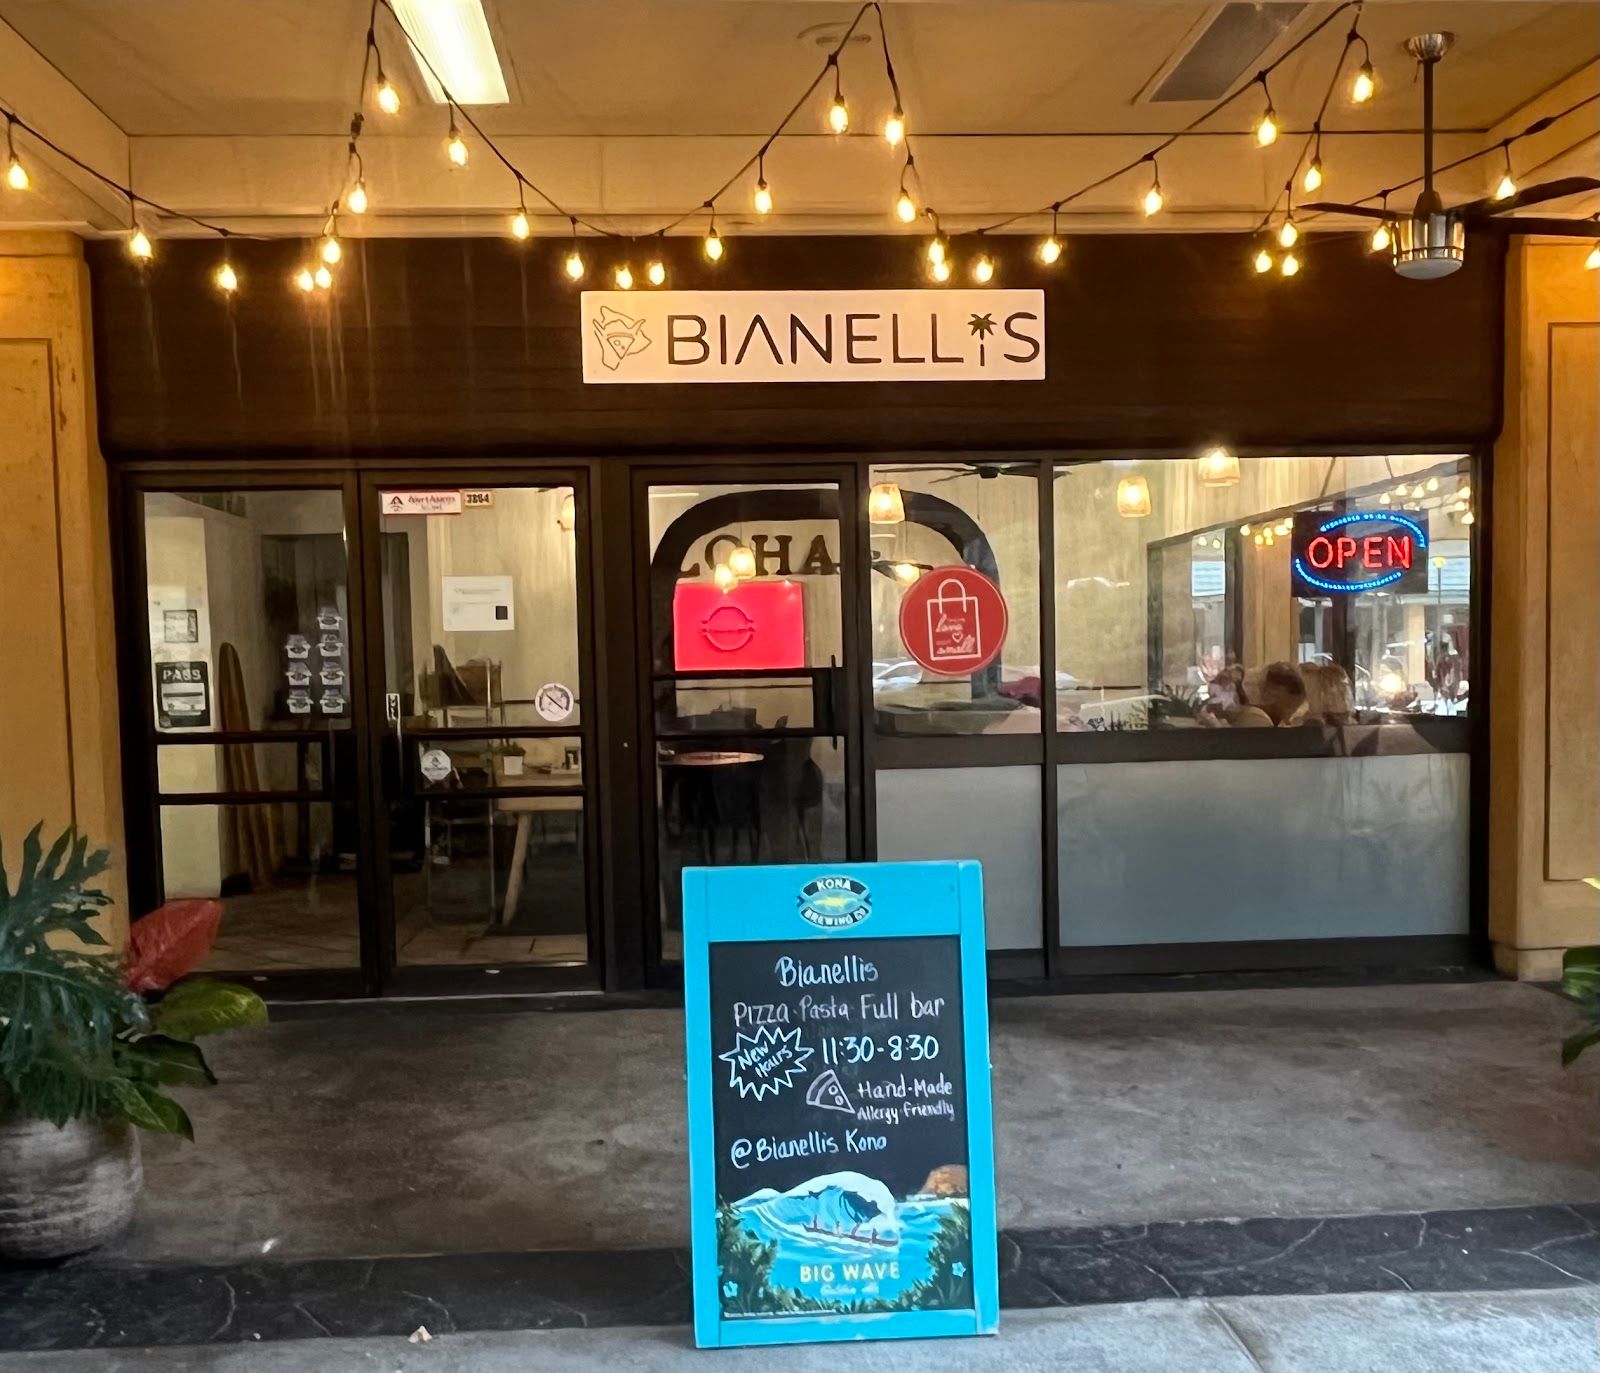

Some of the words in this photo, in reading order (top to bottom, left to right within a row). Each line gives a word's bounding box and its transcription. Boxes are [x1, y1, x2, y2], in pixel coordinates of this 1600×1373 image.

[1308, 536, 1412, 569] OPEN
[162, 668, 202, 681] PASS
[816, 878, 852, 891] KONA
[803, 908, 854, 926] BREWING
[774, 955, 879, 987] Bianellis
[860, 992, 898, 1020] Full
[910, 991, 945, 1018] bar
[737, 1040, 769, 1070] New
[800, 1264, 835, 1283] BIG
[842, 1261, 901, 1281] WAVE
